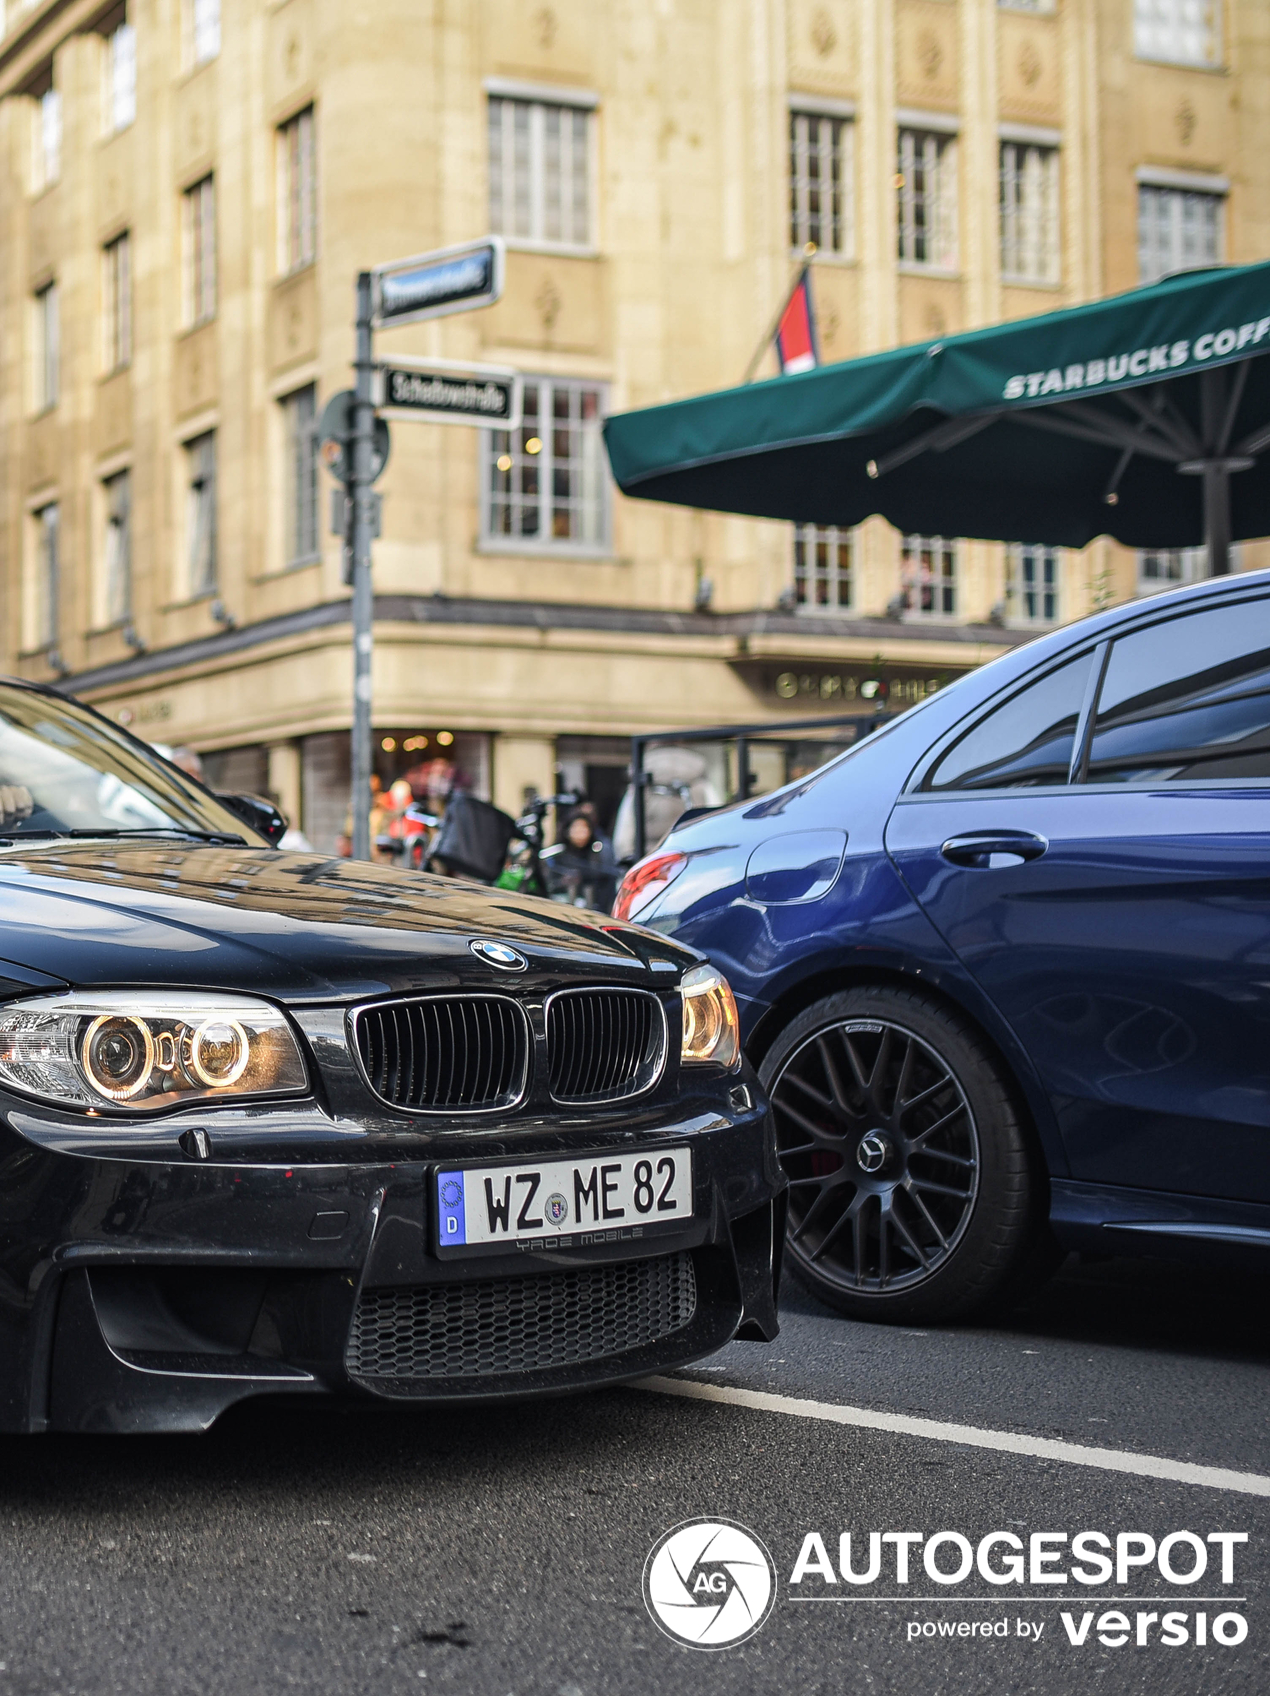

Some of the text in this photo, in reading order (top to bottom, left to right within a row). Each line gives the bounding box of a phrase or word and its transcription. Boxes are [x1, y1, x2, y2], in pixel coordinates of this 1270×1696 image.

[1003, 341, 1189, 399] STARBUCKS
[484, 1172, 543, 1233] WZ
[573, 1163, 625, 1223] ME
[633, 1157, 677, 1214] 82
[446, 1217, 458, 1234] D
[581, 1227, 643, 1245] MOBILE
